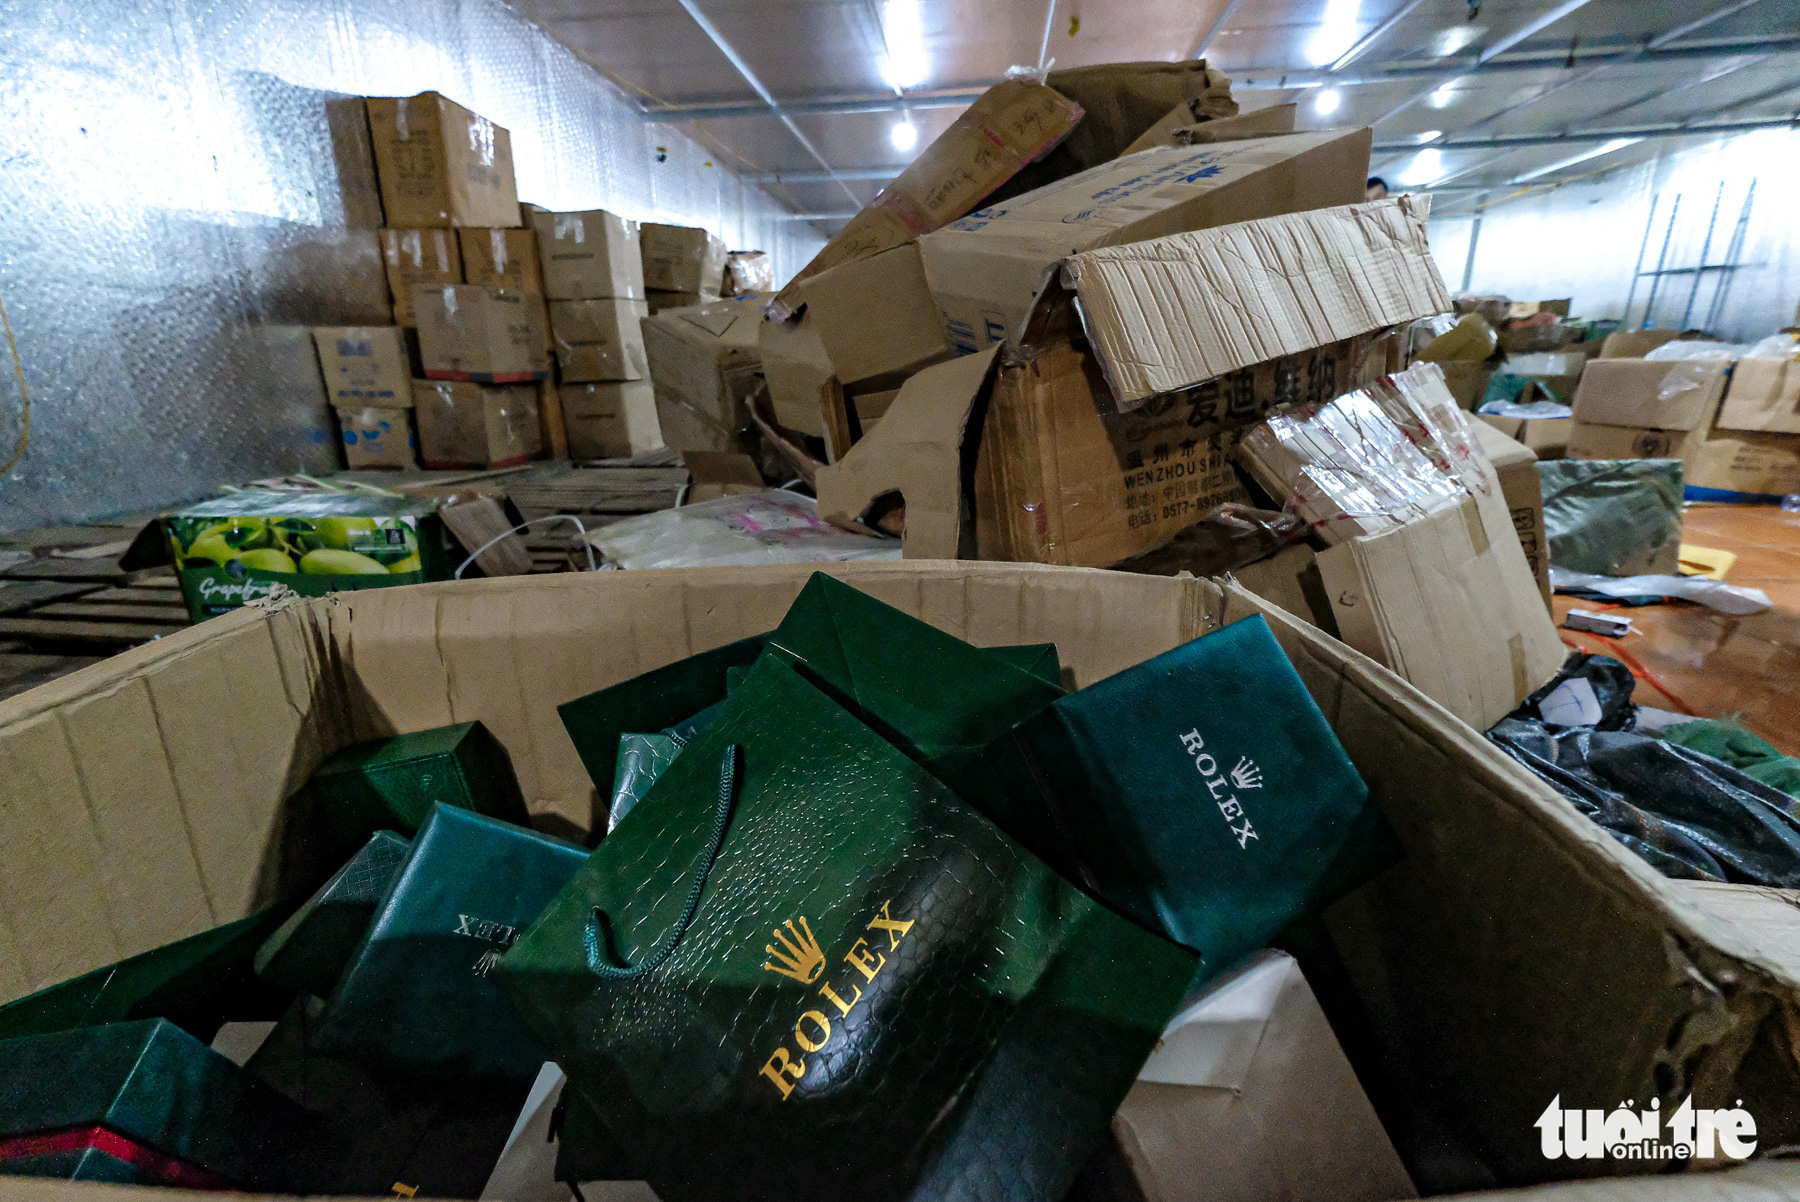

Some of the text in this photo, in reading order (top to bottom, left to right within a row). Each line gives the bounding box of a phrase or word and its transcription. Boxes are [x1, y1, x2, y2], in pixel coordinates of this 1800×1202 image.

[1124, 461, 1196, 489] WENZHOU
[1179, 728, 1259, 849] ROLEX
[453, 914, 521, 945] LEX
[760, 900, 915, 1100] ROLEX
